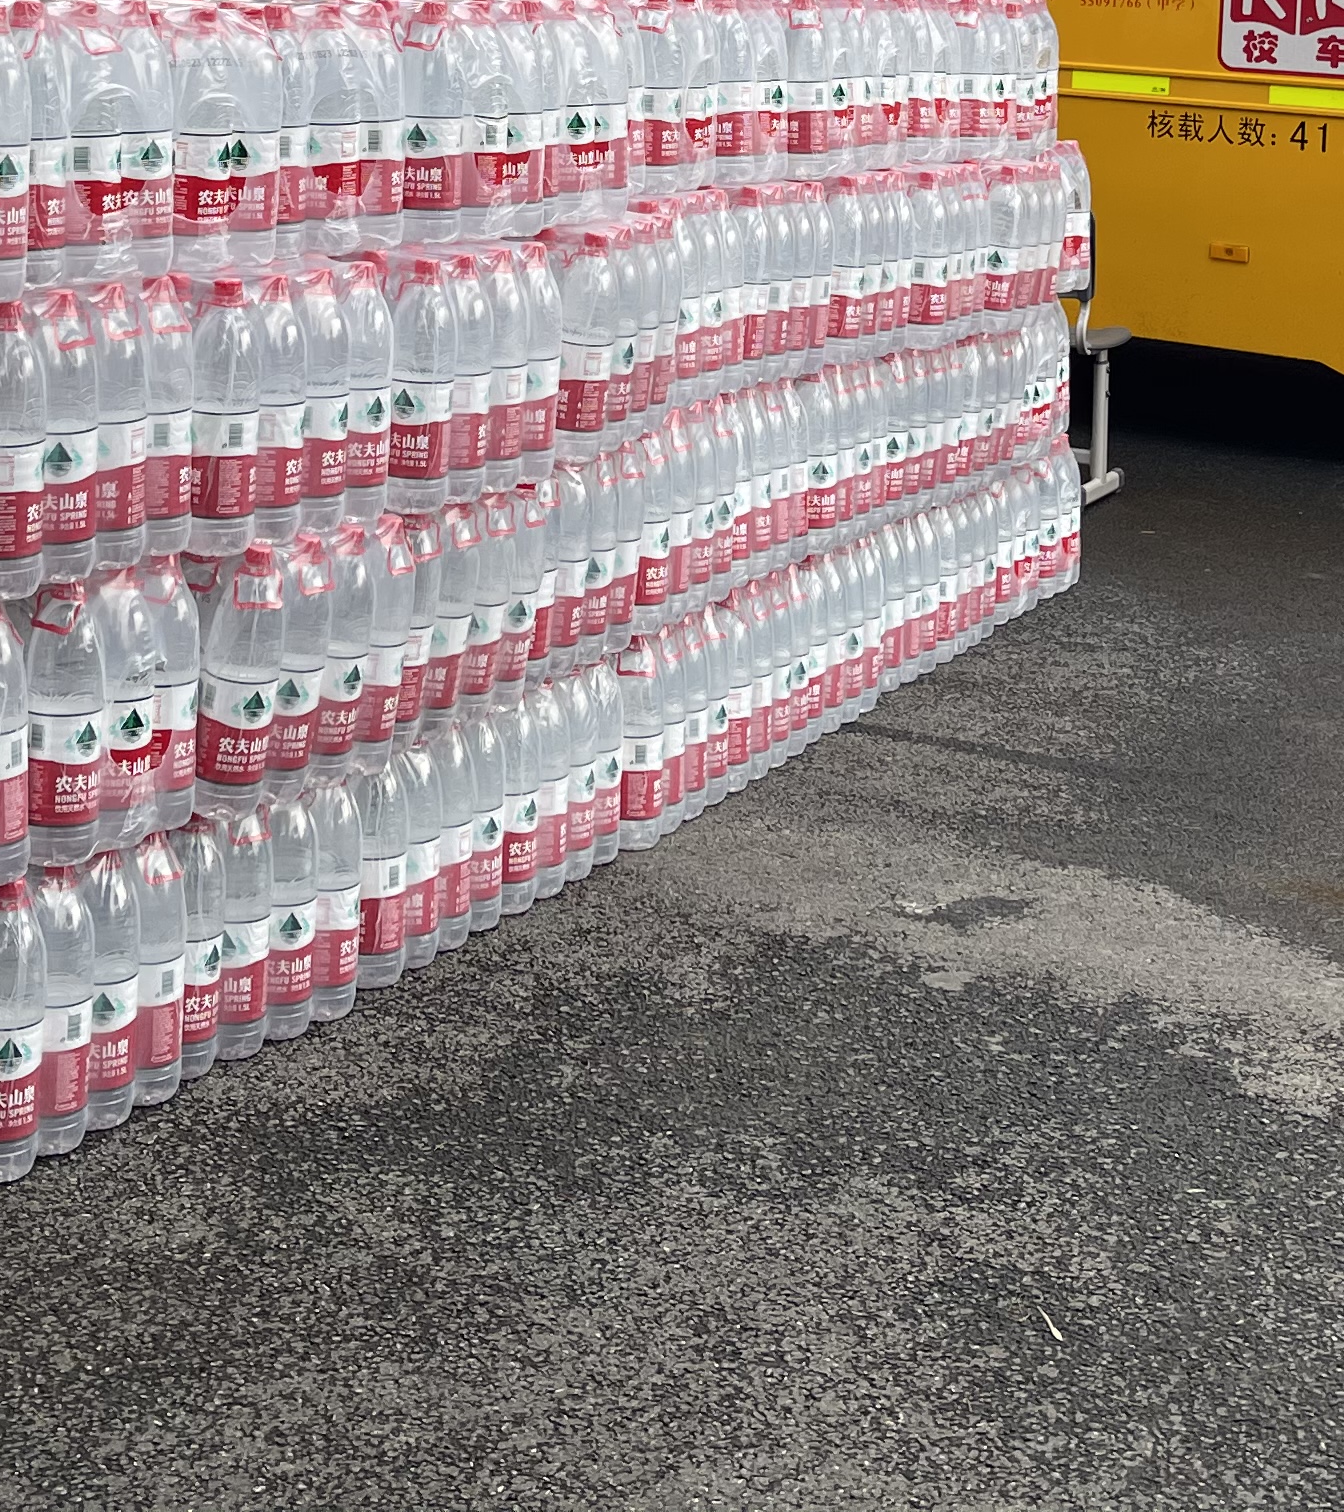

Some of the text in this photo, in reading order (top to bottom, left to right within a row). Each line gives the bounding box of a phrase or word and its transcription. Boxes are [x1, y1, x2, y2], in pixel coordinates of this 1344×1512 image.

[1146, 109, 1278, 149] 核载人数：
[1289, 120, 1329, 155] 41
